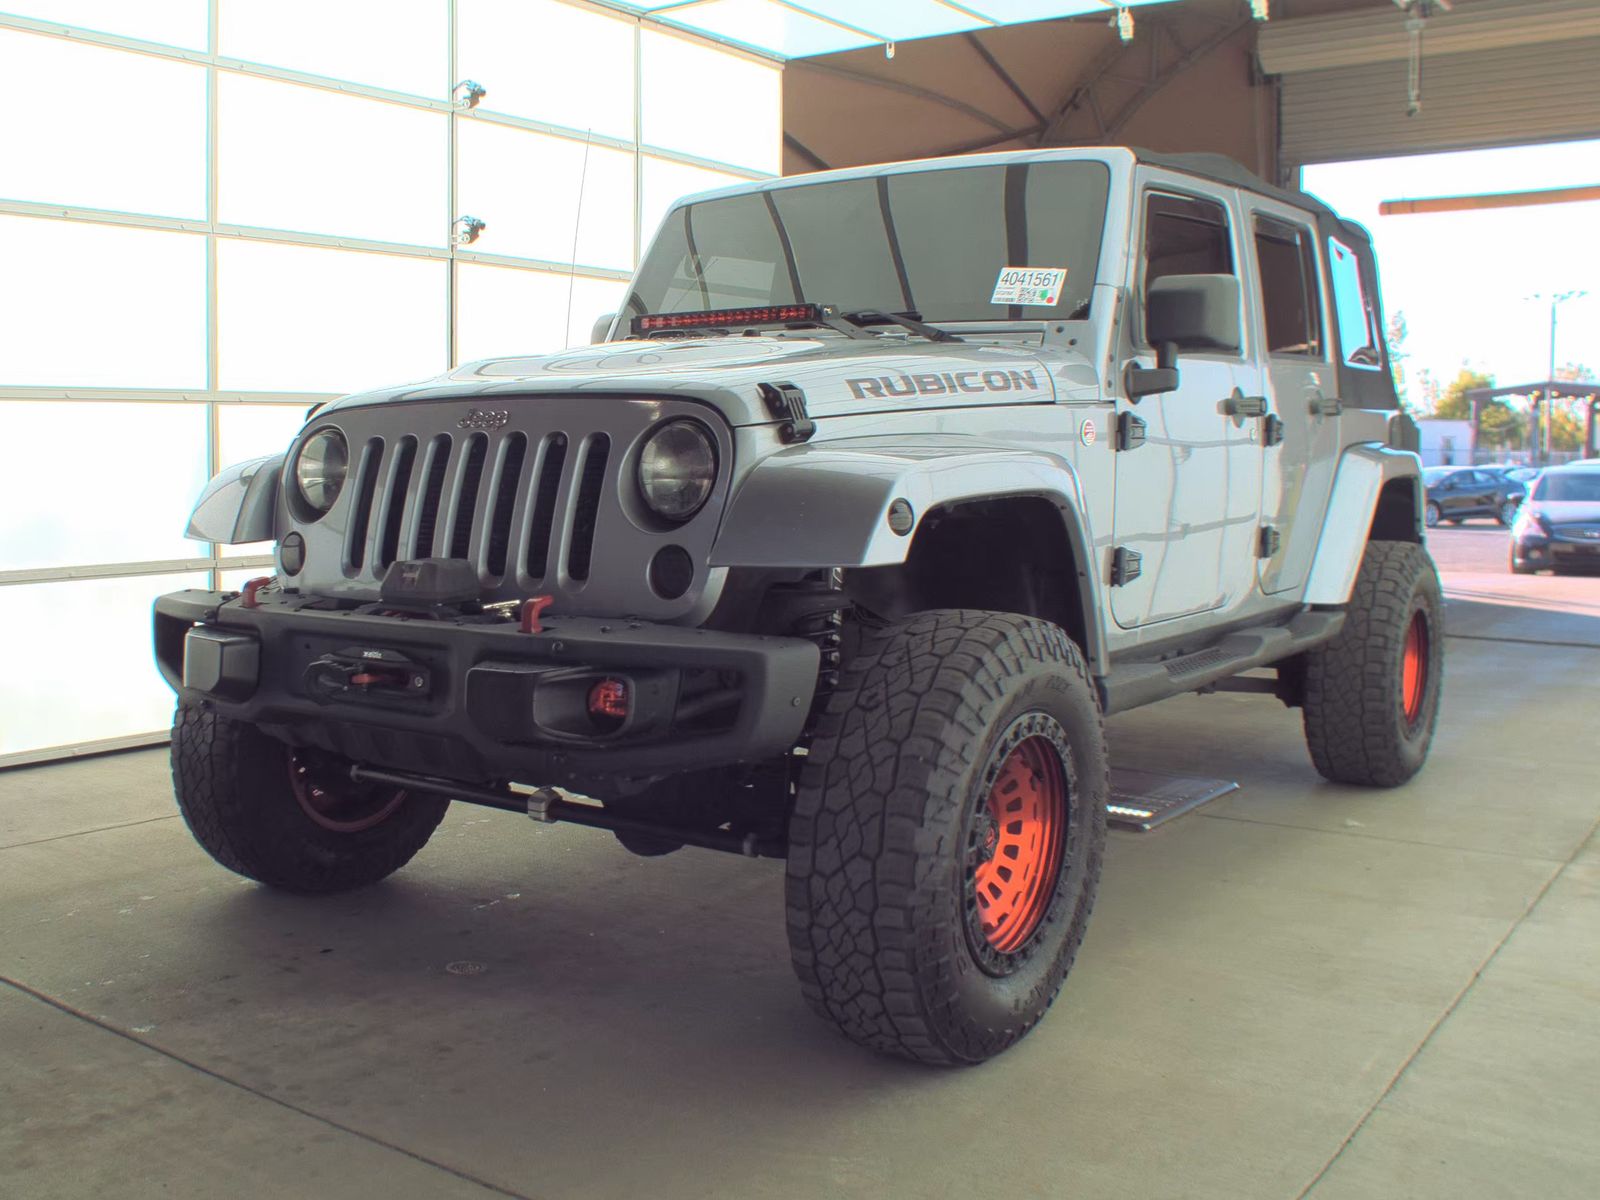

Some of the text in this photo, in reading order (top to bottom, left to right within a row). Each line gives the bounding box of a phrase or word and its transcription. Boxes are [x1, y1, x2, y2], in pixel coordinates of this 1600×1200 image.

[1001, 270, 1058, 287] 4041561
[845, 369, 1039, 400] RUBICON
[456, 408, 509, 431] Jeep
